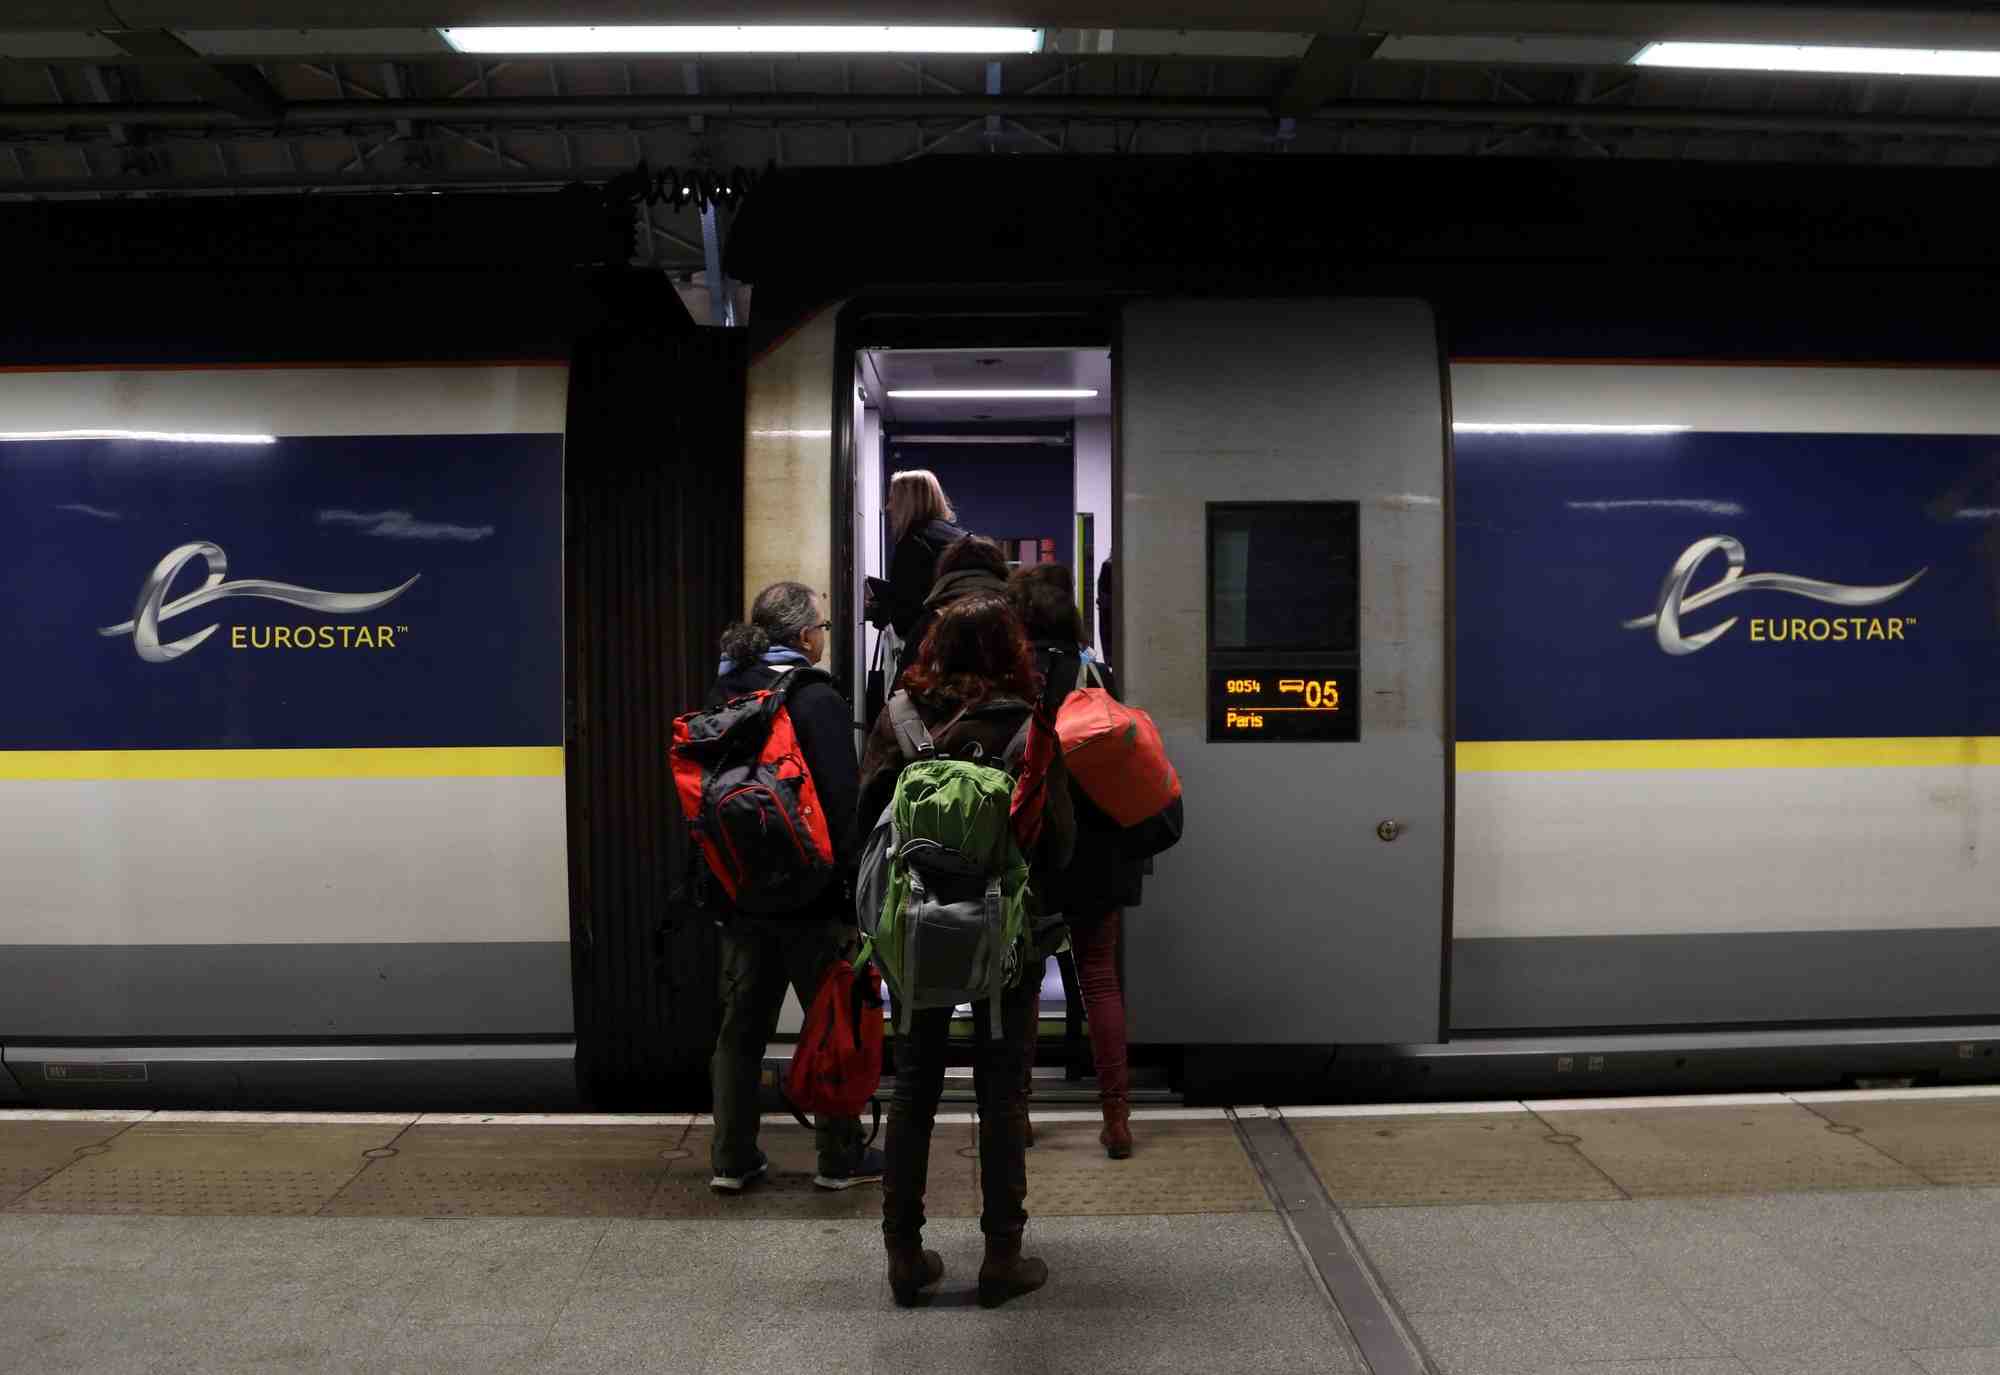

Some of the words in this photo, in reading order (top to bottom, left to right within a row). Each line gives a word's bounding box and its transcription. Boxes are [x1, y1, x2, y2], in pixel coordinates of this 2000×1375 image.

[1227, 680, 1260, 693] 9054
[1305, 681, 1338, 707] 05
[1227, 713, 1263, 727] Paris
